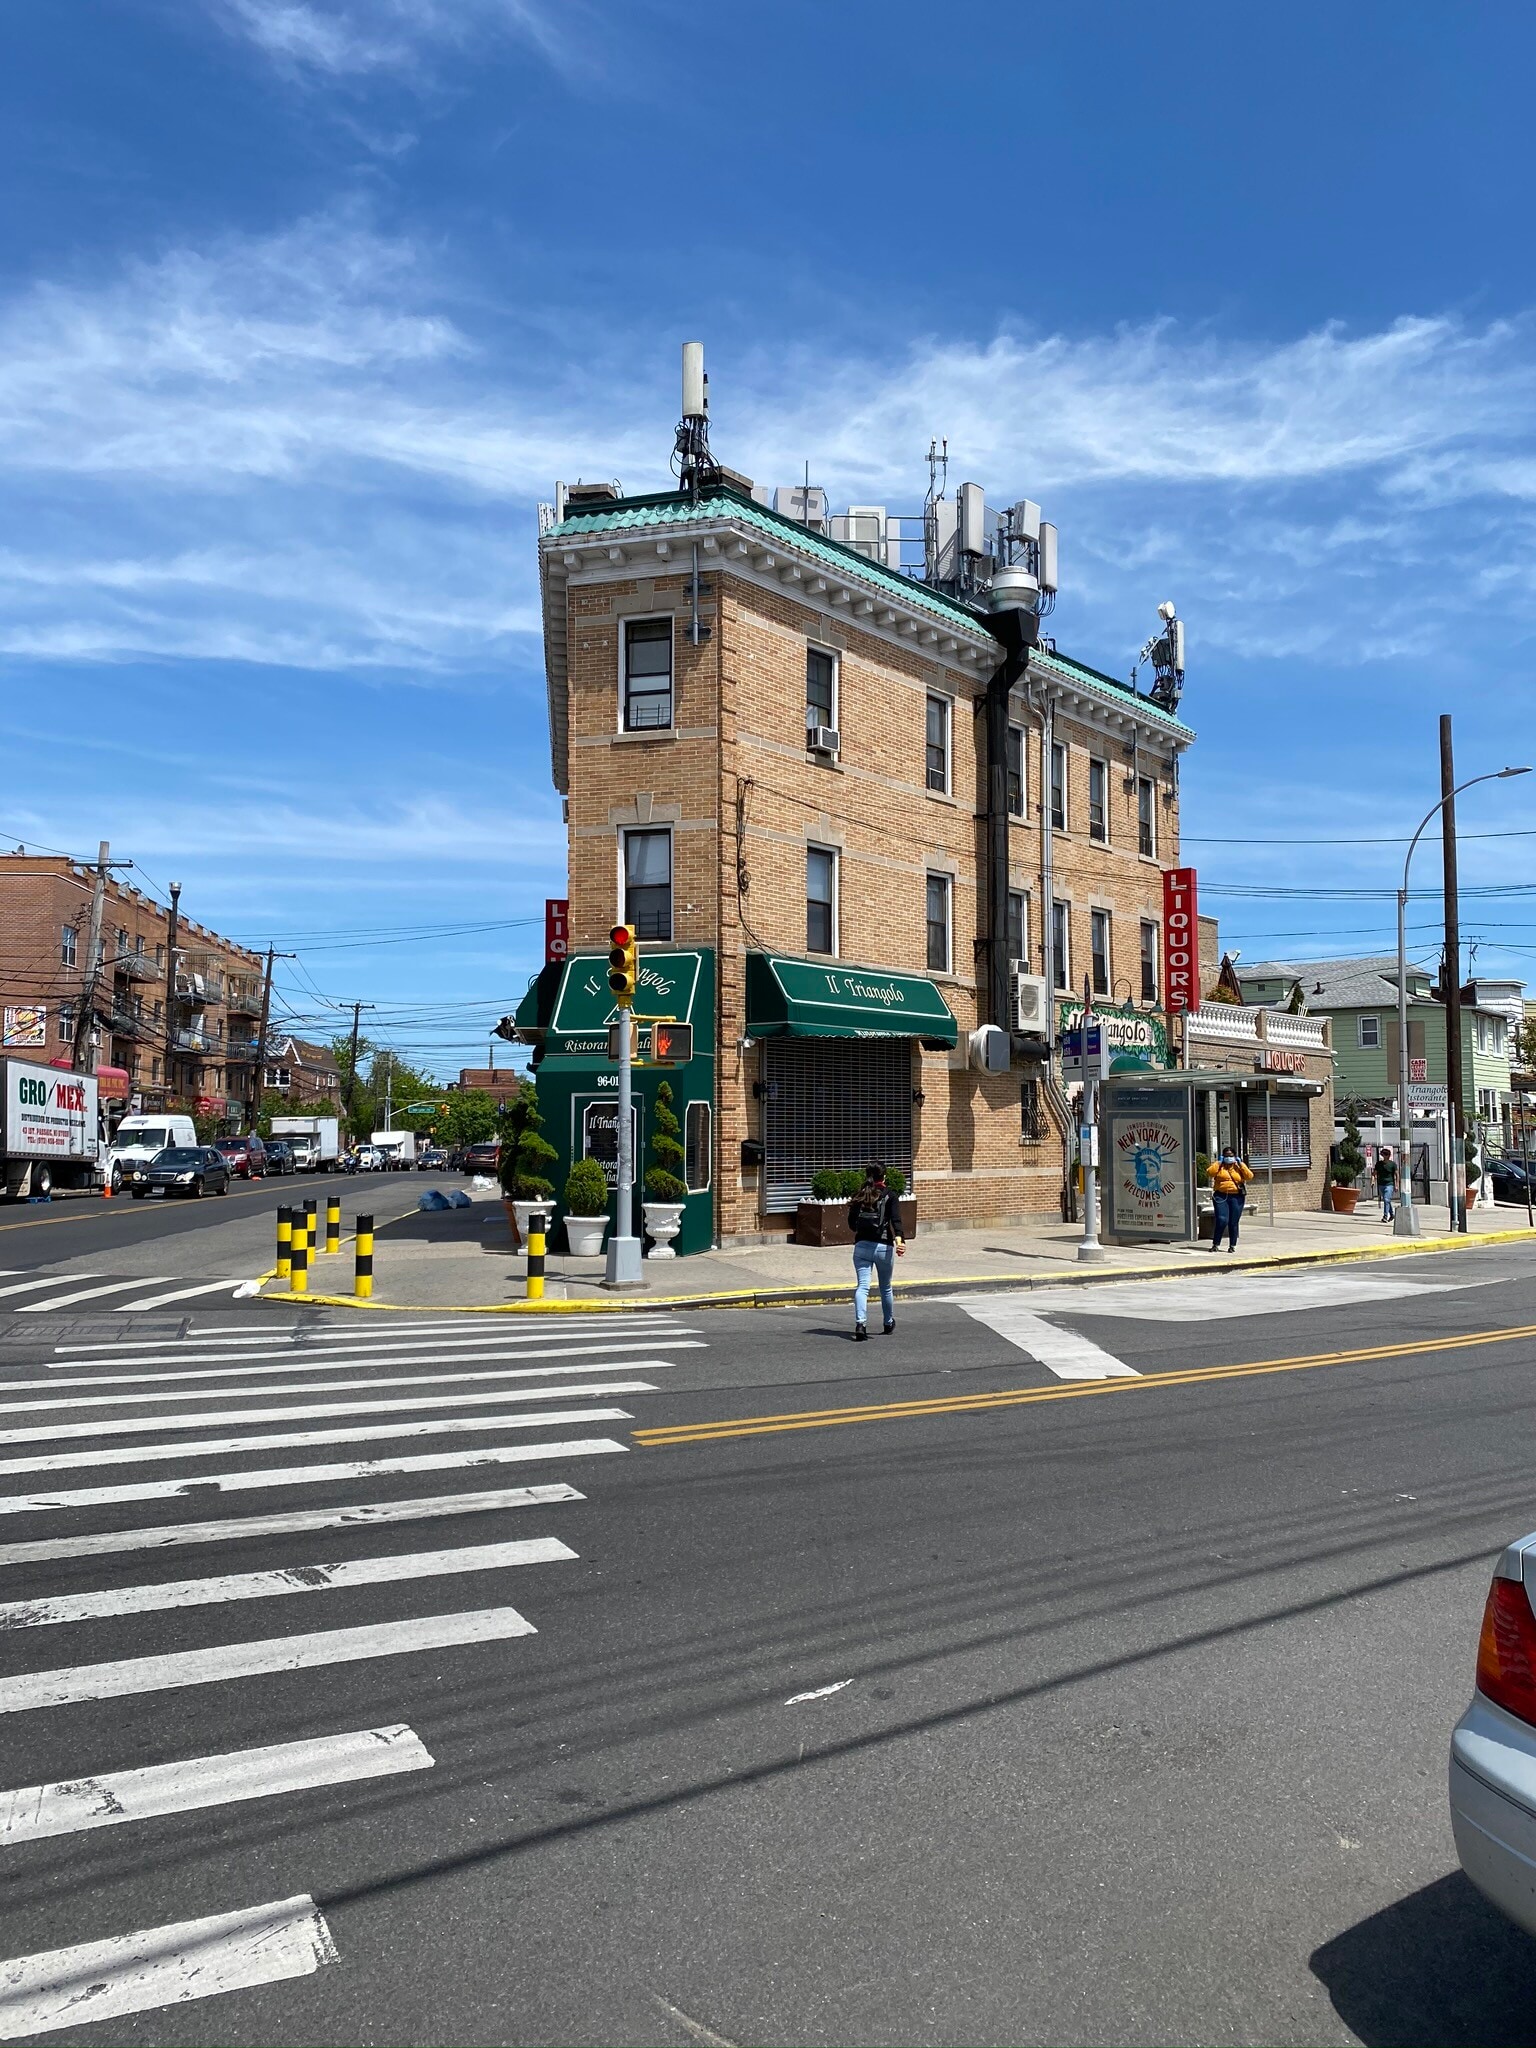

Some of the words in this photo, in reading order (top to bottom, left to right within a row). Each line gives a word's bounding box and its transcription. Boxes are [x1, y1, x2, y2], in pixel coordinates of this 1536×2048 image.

[1168, 874, 1189, 1006] LIQUORS
[583, 975, 601, 997] Il
[825, 975, 840, 994] Il
[844, 978, 904, 1006] Triangolo
[1266, 1050, 1306, 1072] LIQUORS
[19, 1077, 46, 1107] GRO
[56, 1083, 83, 1112] MEX
[1408, 1094, 1447, 1102] istorante
[589, 1115, 597, 1129] Il
[1126, 1121, 1145, 1131] FAMOUS
[1147, 1121, 1168, 1131] ORIGINAL
[1117, 1131, 1136, 1151] NEW
[1136, 1128, 1160, 1143] YORK
[1161, 1133, 1180, 1152] CITY
[1123, 1179, 1160, 1200] WELCOMES
[1161, 1180, 1176, 1197] YOU
[1138, 1200, 1160, 1208] ALWAYS
